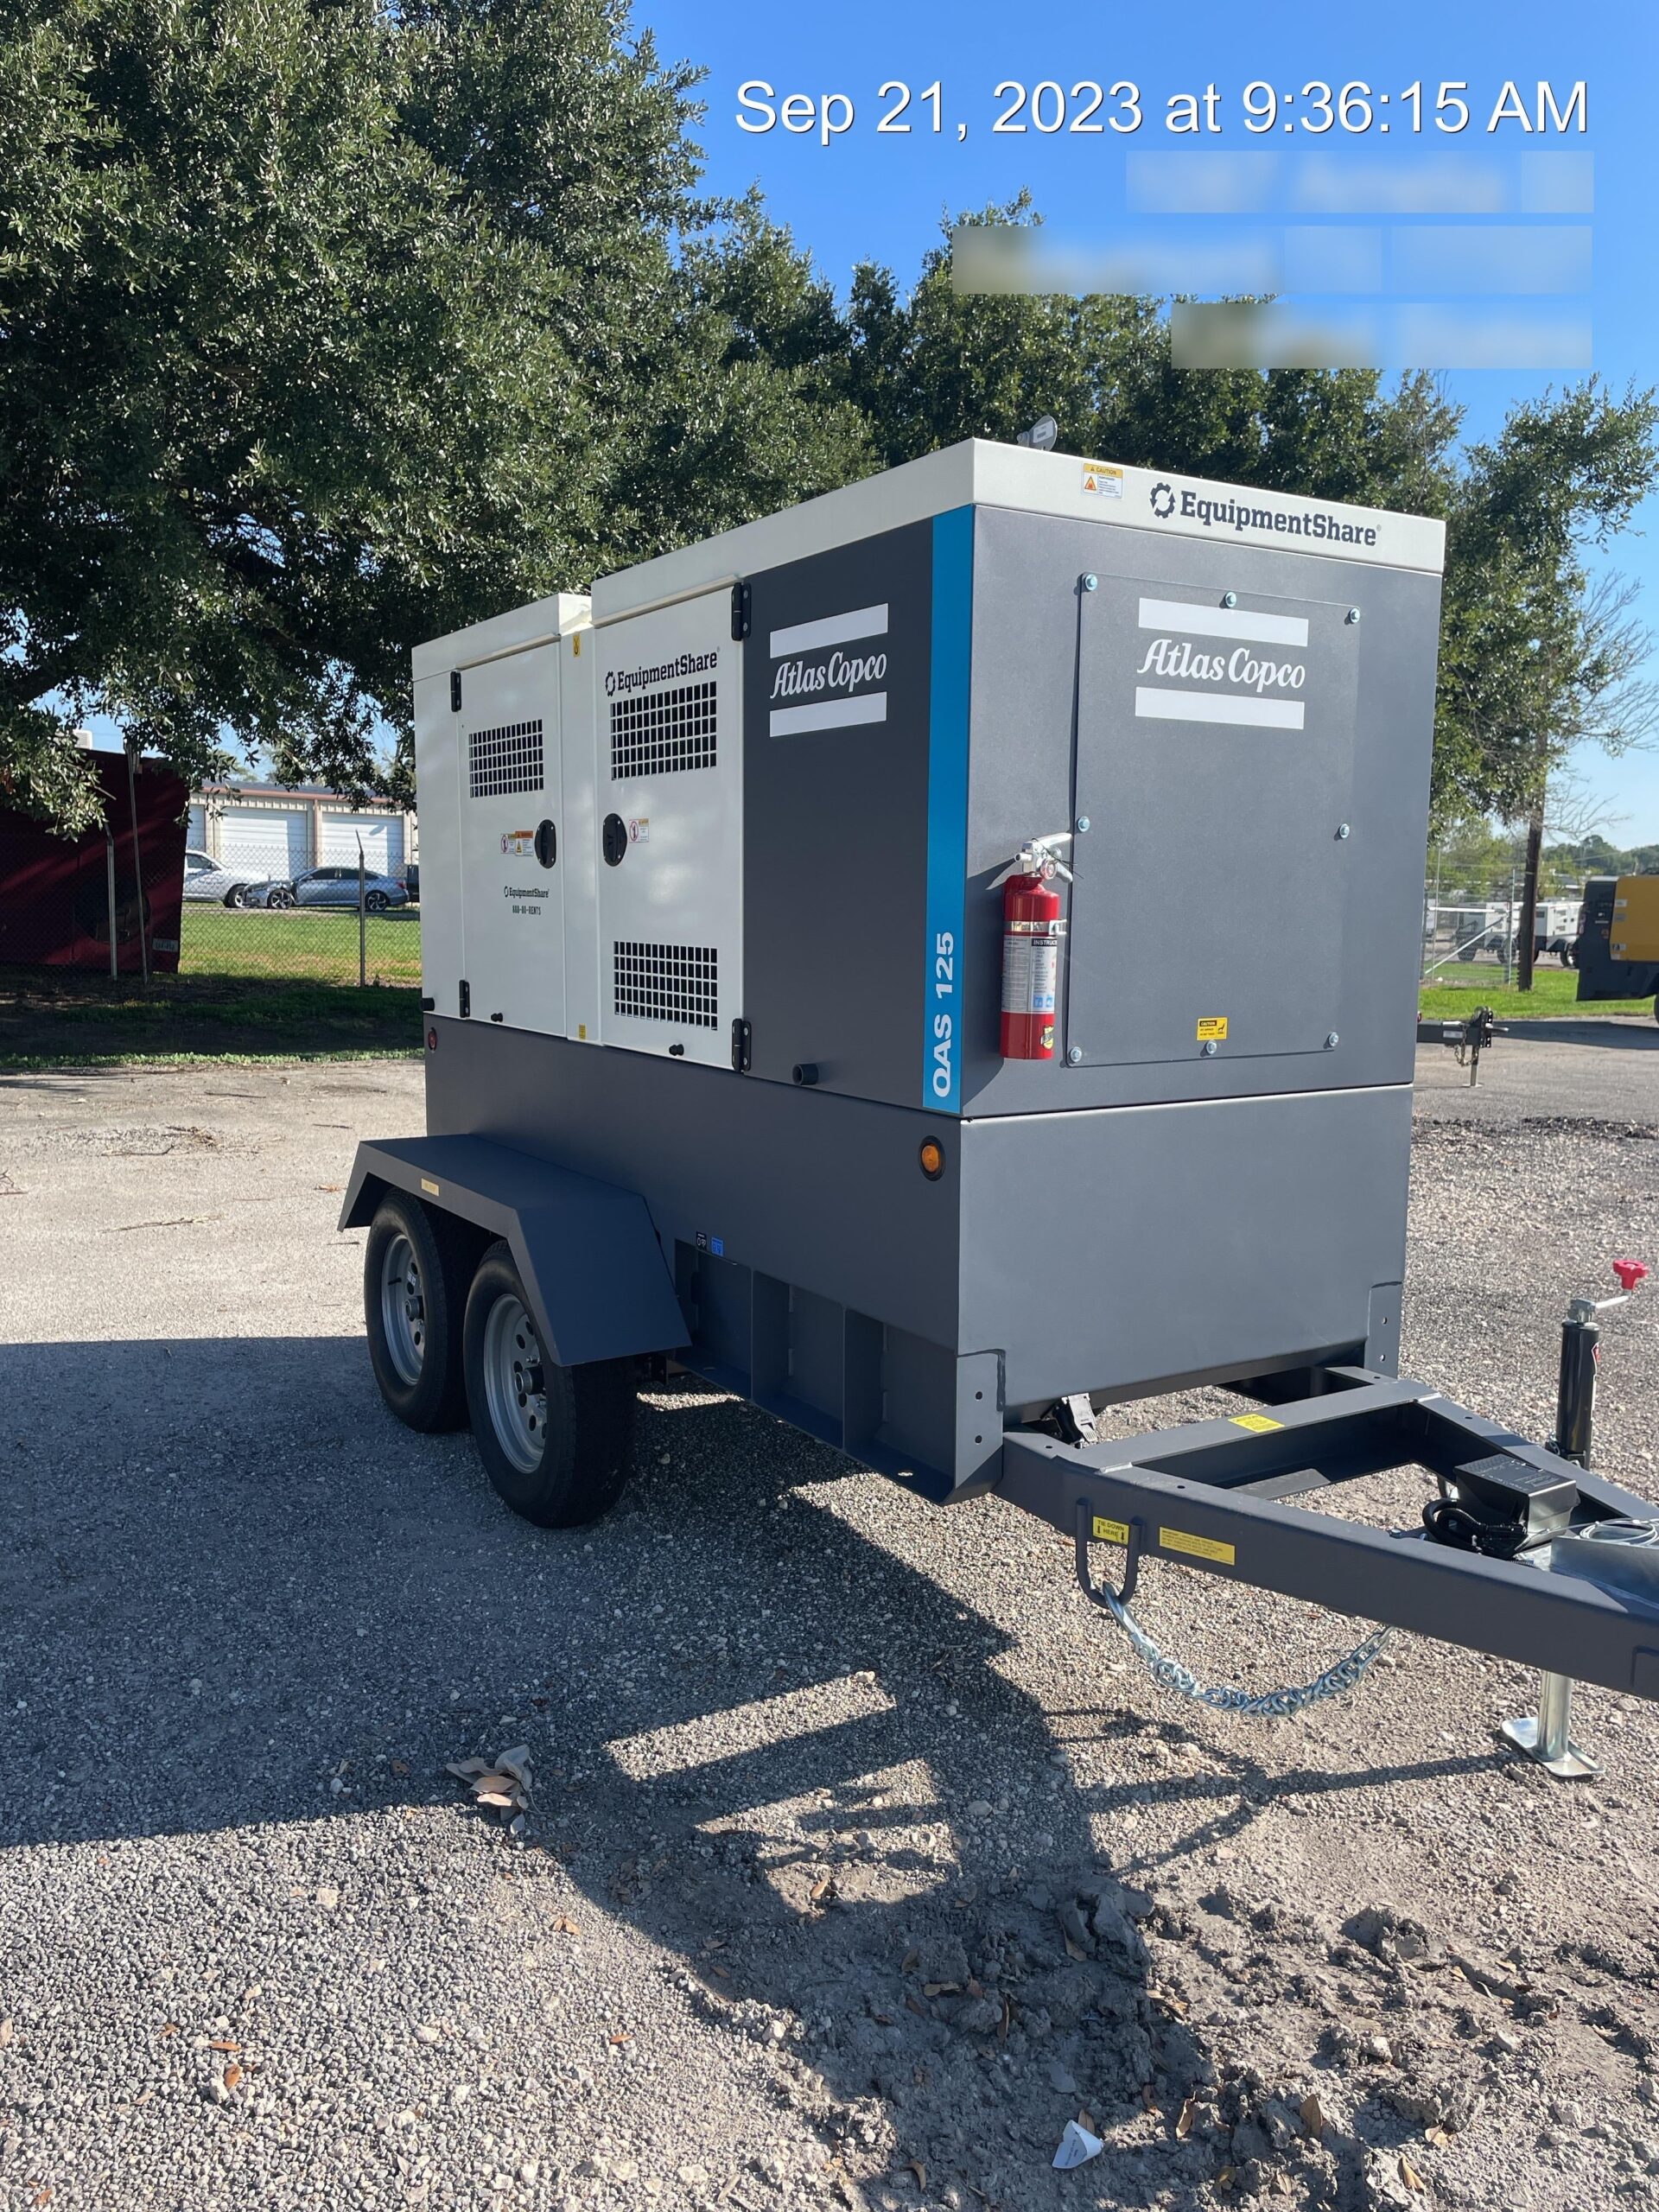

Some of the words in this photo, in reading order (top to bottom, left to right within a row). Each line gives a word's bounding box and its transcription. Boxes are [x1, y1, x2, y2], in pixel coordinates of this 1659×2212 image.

[1096, 467, 1117, 475] CAUTION
[1180, 490, 1376, 546] EquipmentShare
[617, 652, 717, 693] EquipmentShare
[510, 887, 549, 899] EquipmentShare
[936, 931, 954, 1000] 125
[932, 1014, 952, 1097] QAS
[1103, 1529, 1119, 1537] HERE
[1107, 1522, 1125, 1531] DOWN
